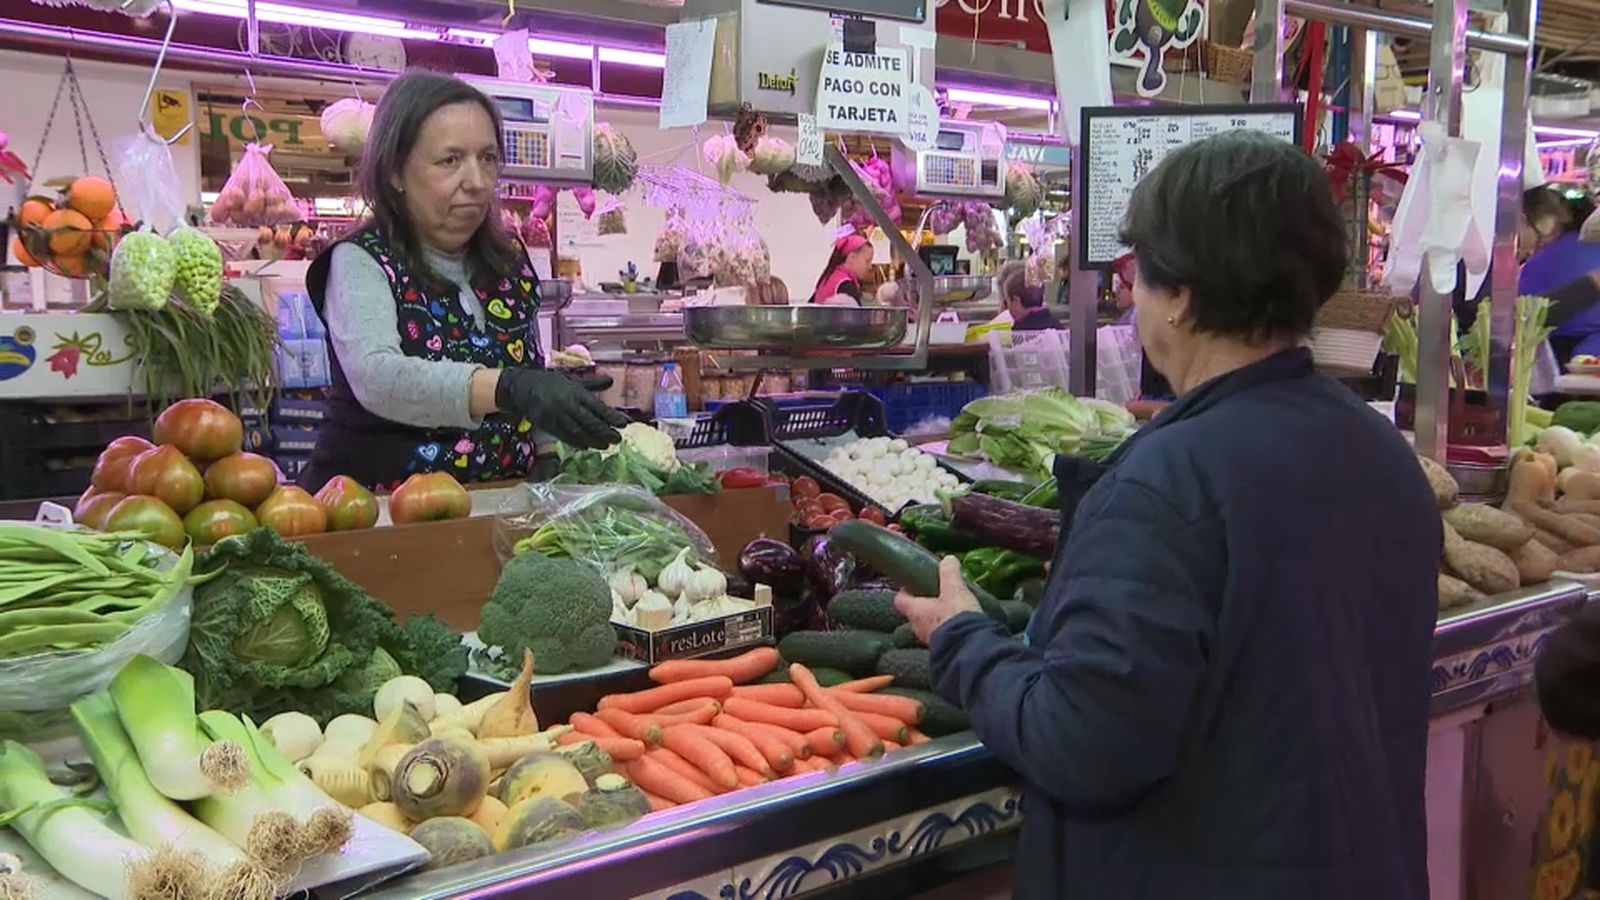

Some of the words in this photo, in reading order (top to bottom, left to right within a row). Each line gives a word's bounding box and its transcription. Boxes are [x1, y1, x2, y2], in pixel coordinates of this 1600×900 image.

[826, 50, 839, 66] SE
[844, 53, 901, 71] ADMITE
[824, 77, 864, 94] PAGO
[869, 82, 901, 97] CON
[827, 105, 897, 122] TARJETA
[1006, 144, 1045, 162] JAVI
